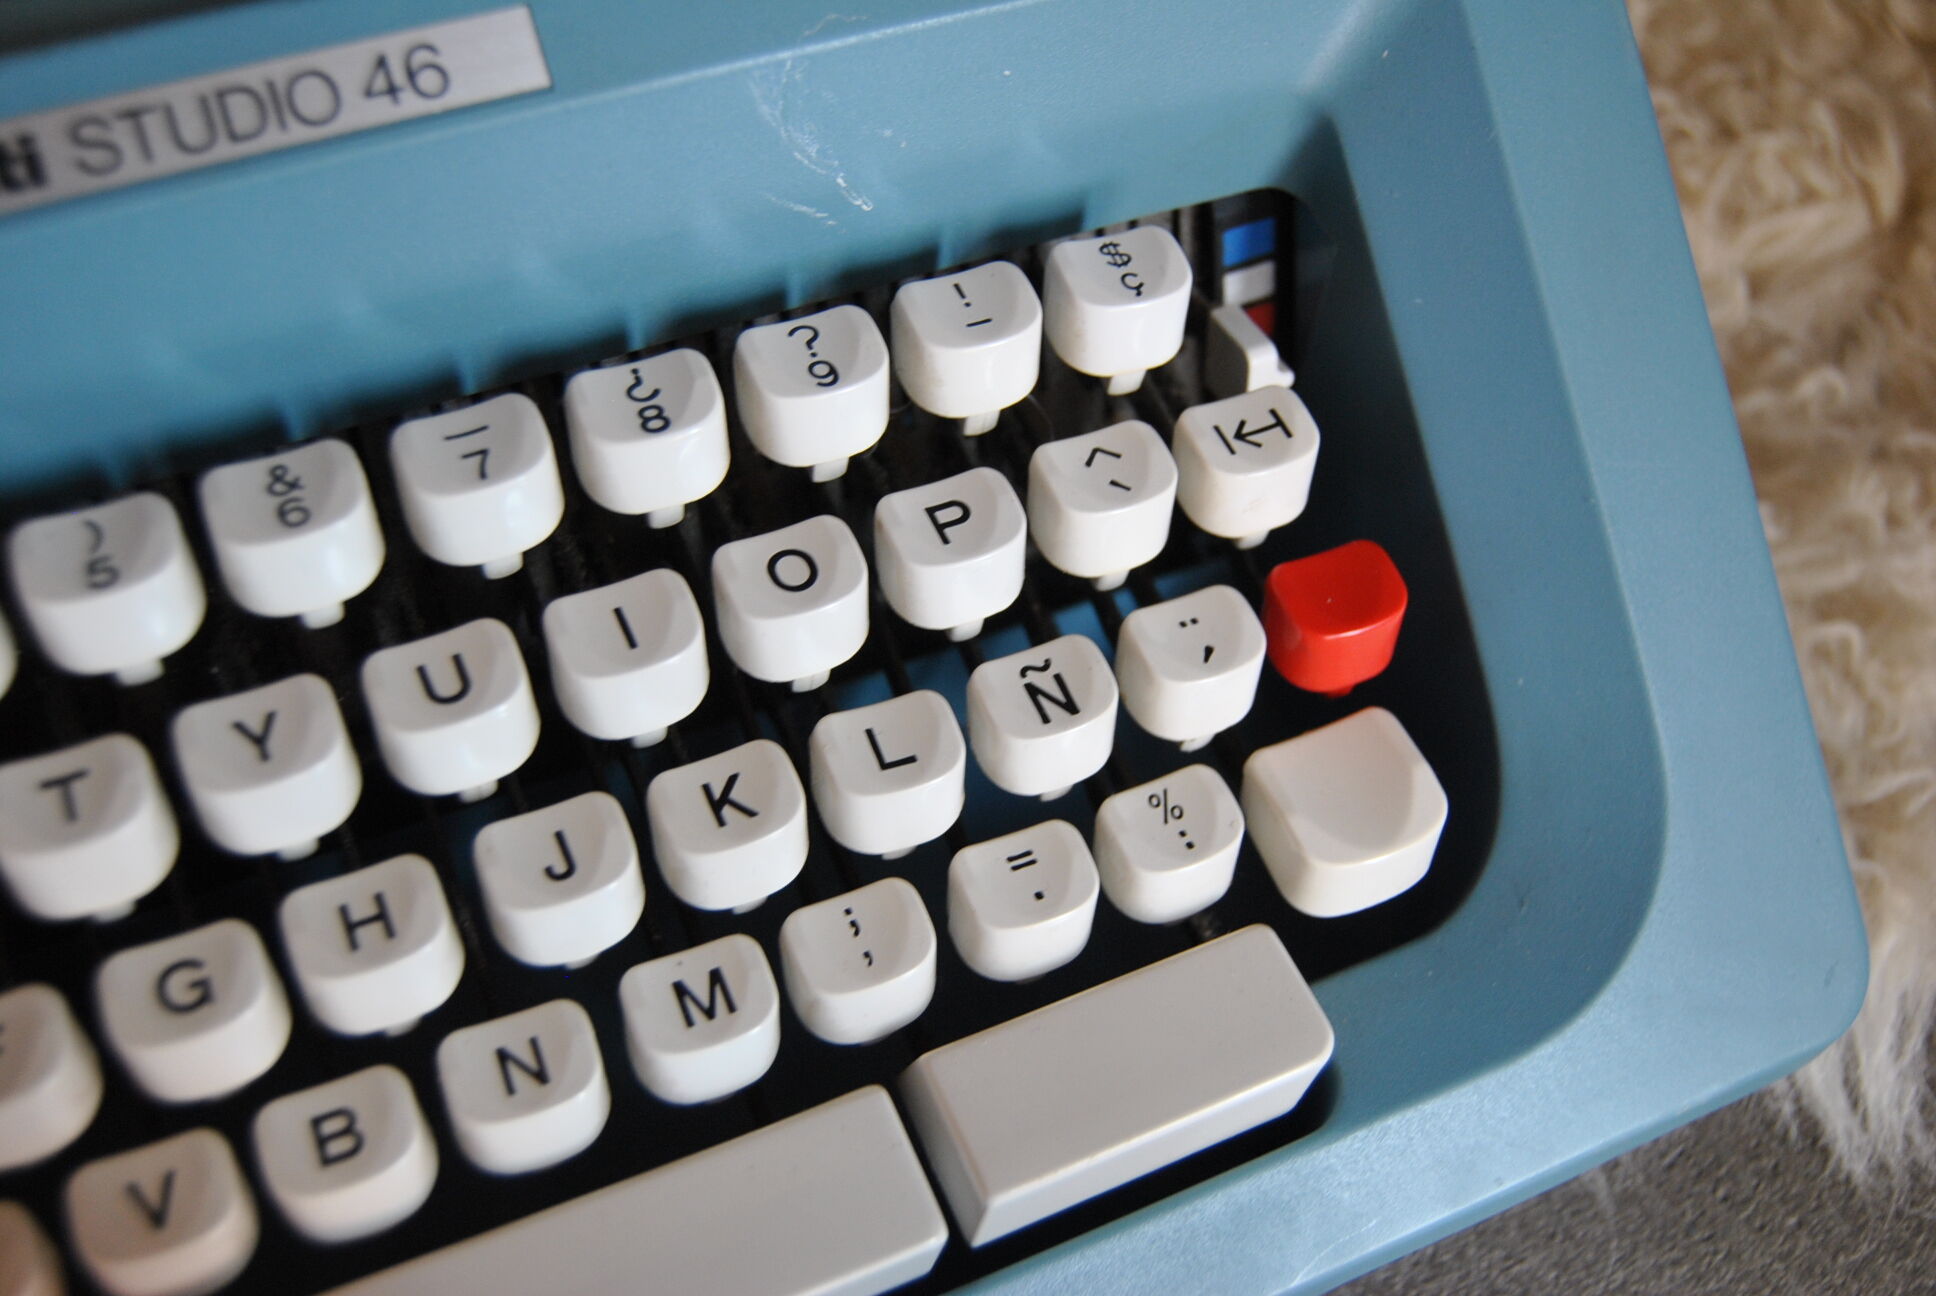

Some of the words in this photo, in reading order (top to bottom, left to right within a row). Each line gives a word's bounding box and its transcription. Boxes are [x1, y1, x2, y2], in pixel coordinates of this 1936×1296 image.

[68, 69, 342, 177] STUDIO
[363, 43, 450, 106] 46
[1099, 241, 1131, 268] $
[953, 282, 971, 307] !
[787, 324, 819, 357] ?
[625, 368, 661, 402] ¿
[808, 359, 839, 387] 9
[638, 404, 671, 433] 8
[266, 464, 304, 497] &
[461, 448, 490, 480] 7
[277, 499, 311, 528] 6
[925, 499, 971, 545] P
[84, 519, 104, 554] )
[85, 556, 120, 591] 5
[767, 548, 818, 593] O
[613, 606, 638, 650] I
[416, 653, 471, 704] U
[1020, 658, 1081, 724] Ñ
[233, 710, 277, 762] Y
[865, 727, 918, 771] L
[39, 769, 91, 822] T
[701, 772, 759, 828] K
[1147, 788, 1184, 824] %
[544, 830, 577, 882] J
[1006, 849, 1038, 871] =
[338, 892, 397, 951] H
[156, 958, 212, 1013] G
[671, 966, 738, 1028] M
[495, 1036, 550, 1096] N
[309, 1108, 367, 1167] B
[127, 1169, 177, 1231] V
